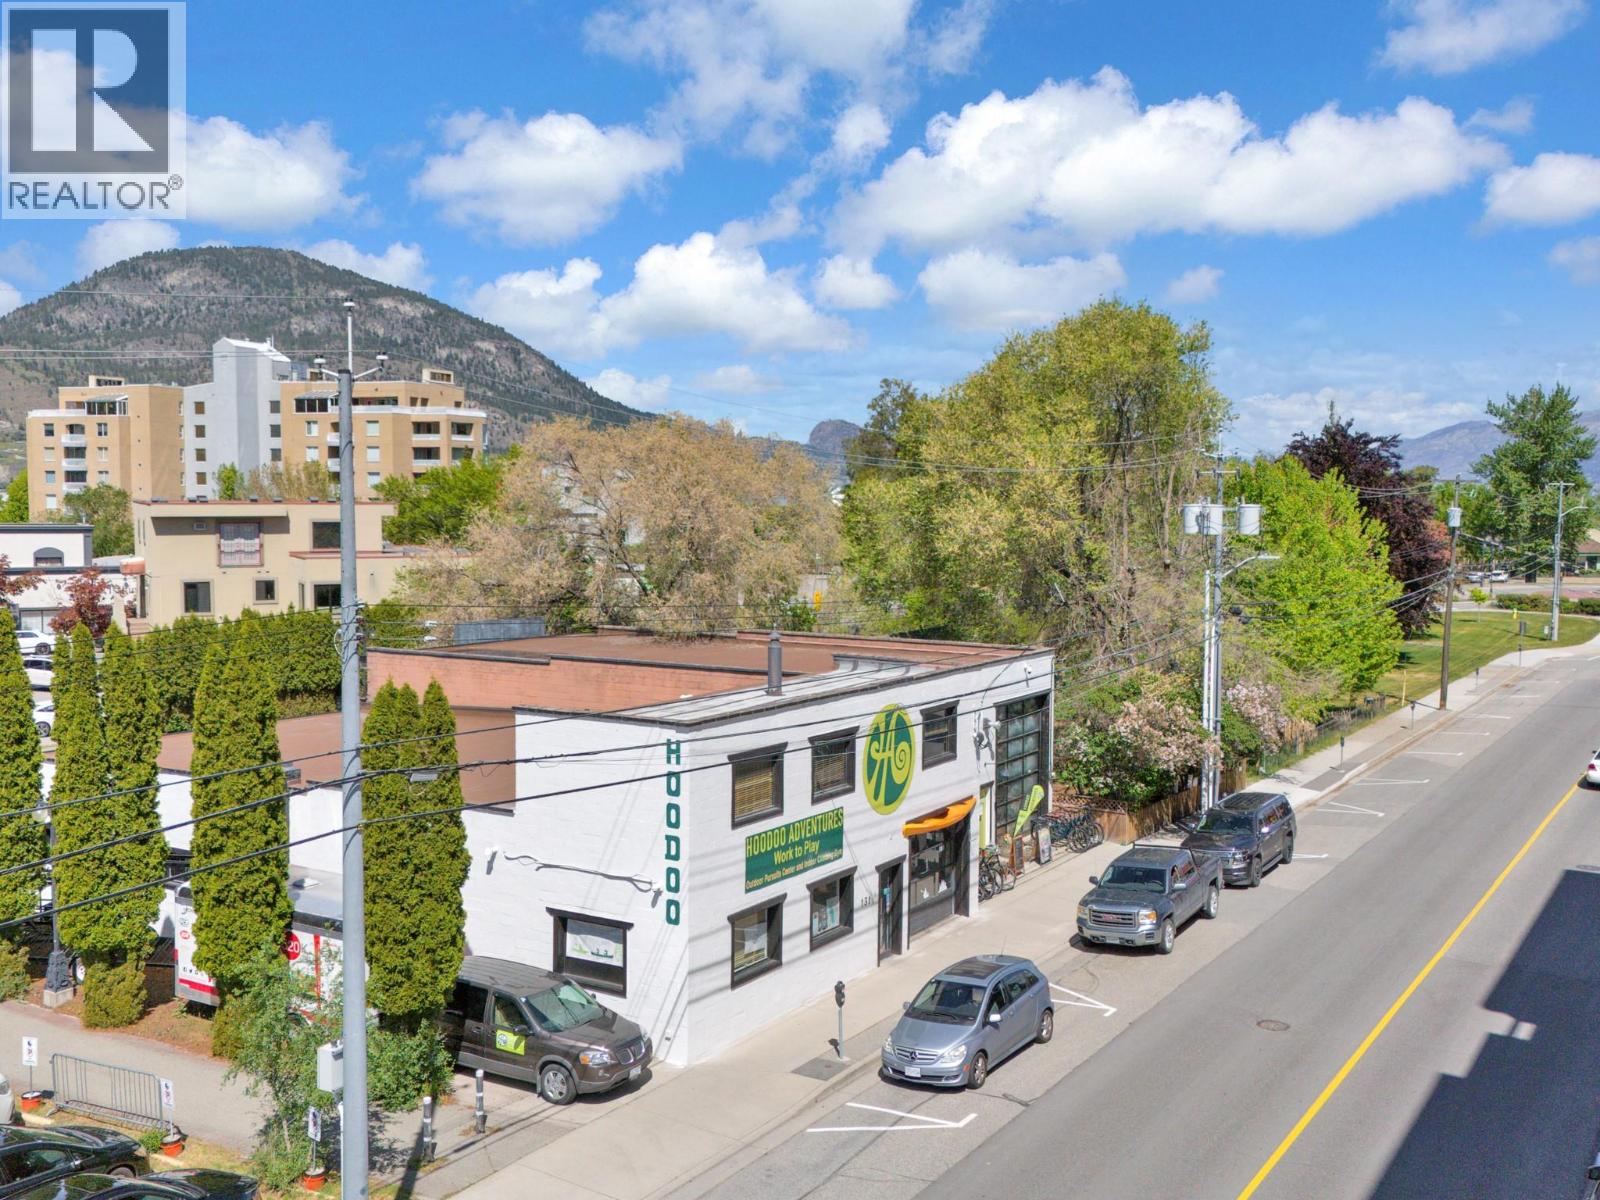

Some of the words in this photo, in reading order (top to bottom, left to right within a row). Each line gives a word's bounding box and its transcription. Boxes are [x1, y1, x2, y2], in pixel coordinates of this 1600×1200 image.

[665, 739, 680, 925] HOODOO
[746, 827, 786, 857] HOODOO
[788, 809, 843, 843] ADVENTURES
[774, 847, 793, 864] Work
[795, 845, 802, 857] to
[804, 840, 819, 854] Play
